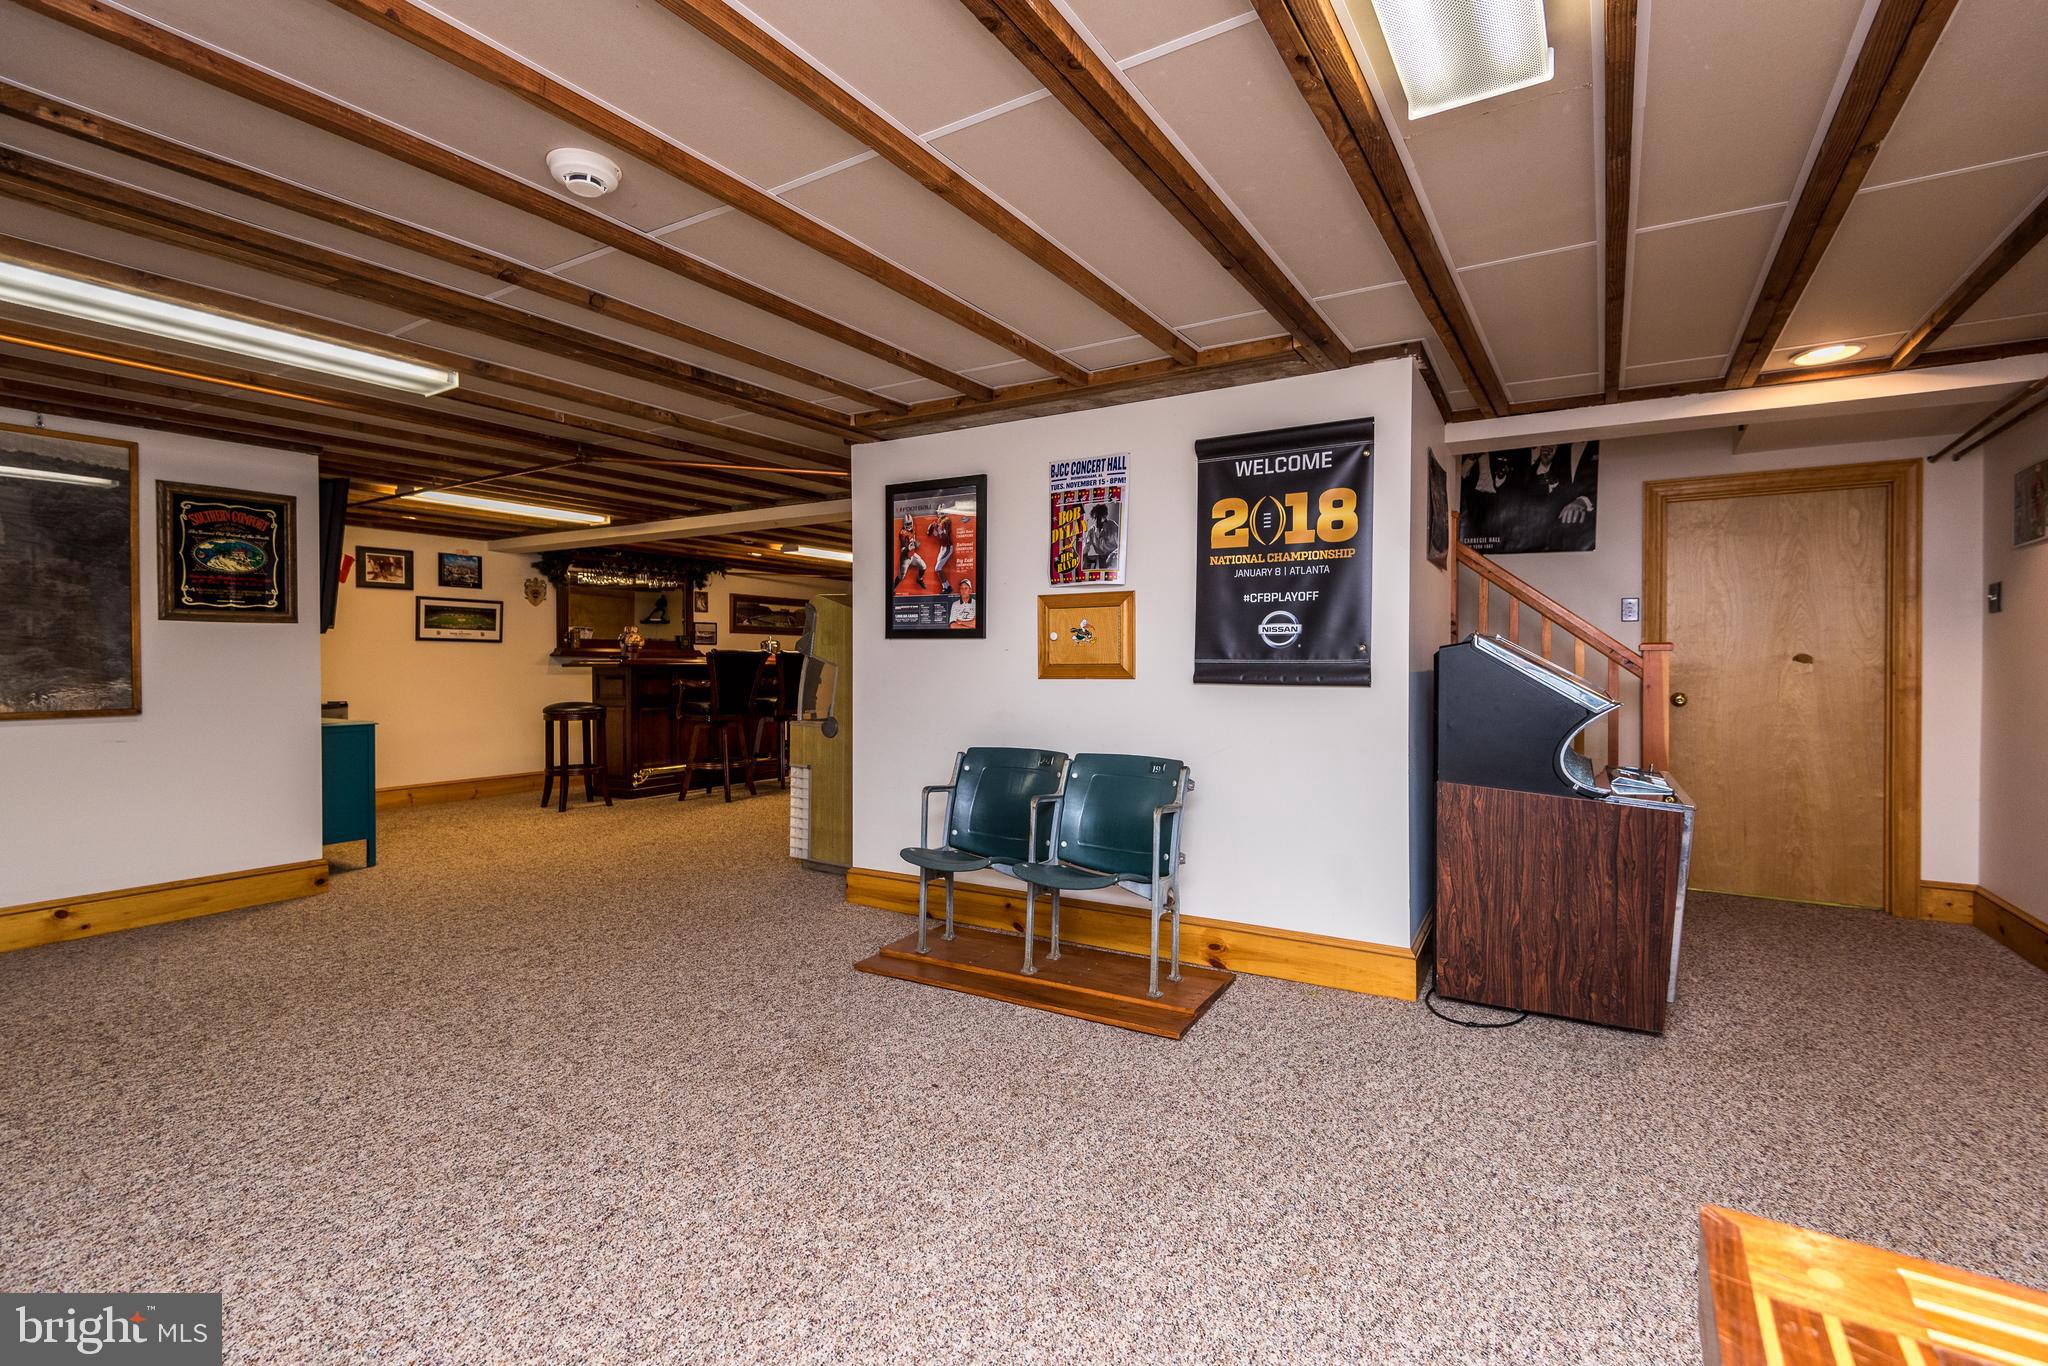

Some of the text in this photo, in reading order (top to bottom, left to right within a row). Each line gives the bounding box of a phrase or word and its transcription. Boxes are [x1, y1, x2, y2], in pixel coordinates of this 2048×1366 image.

[1051, 456, 1127, 478] BJCC CONCERT HALL
[1235, 451, 1333, 477] WELCOME
[1051, 483, 1065, 491] TUES.
[1066, 480, 1097, 488] NOVEMBER
[188, 509, 231, 526] SOUTHERN
[231, 511, 270, 532] COMFORT
[1059, 506, 1081, 526] BOB
[1052, 520, 1087, 544] DYLAN
[1210, 548, 1356, 566] NATIONAL CHAMPIONSHIP
[1234, 565, 1330, 578] JANUARY 8 ATLANTA
[1243, 591, 1319, 603] #CFBPLAYOFF
